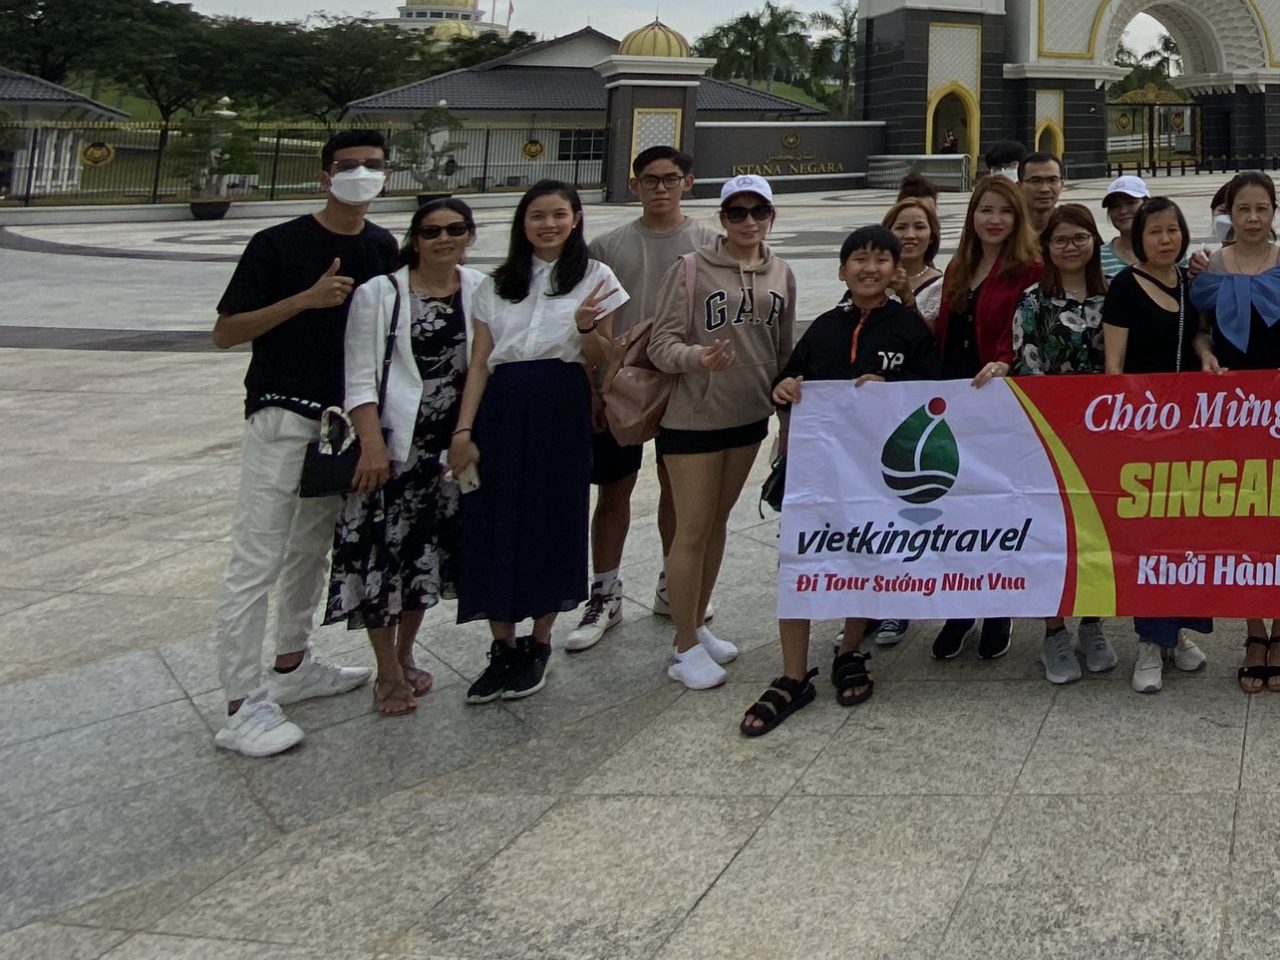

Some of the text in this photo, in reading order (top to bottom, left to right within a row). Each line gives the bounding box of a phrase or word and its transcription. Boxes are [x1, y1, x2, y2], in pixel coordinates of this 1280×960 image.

[731, 162, 844, 176] ISTANA NEGARA
[1084, 390, 1181, 432] Chào
[797, 517, 1033, 563] vietkingtravel
[796, 572, 1026, 597] Đi Tour Sướng Như Vua
[1136, 551, 1207, 586] Khởi
